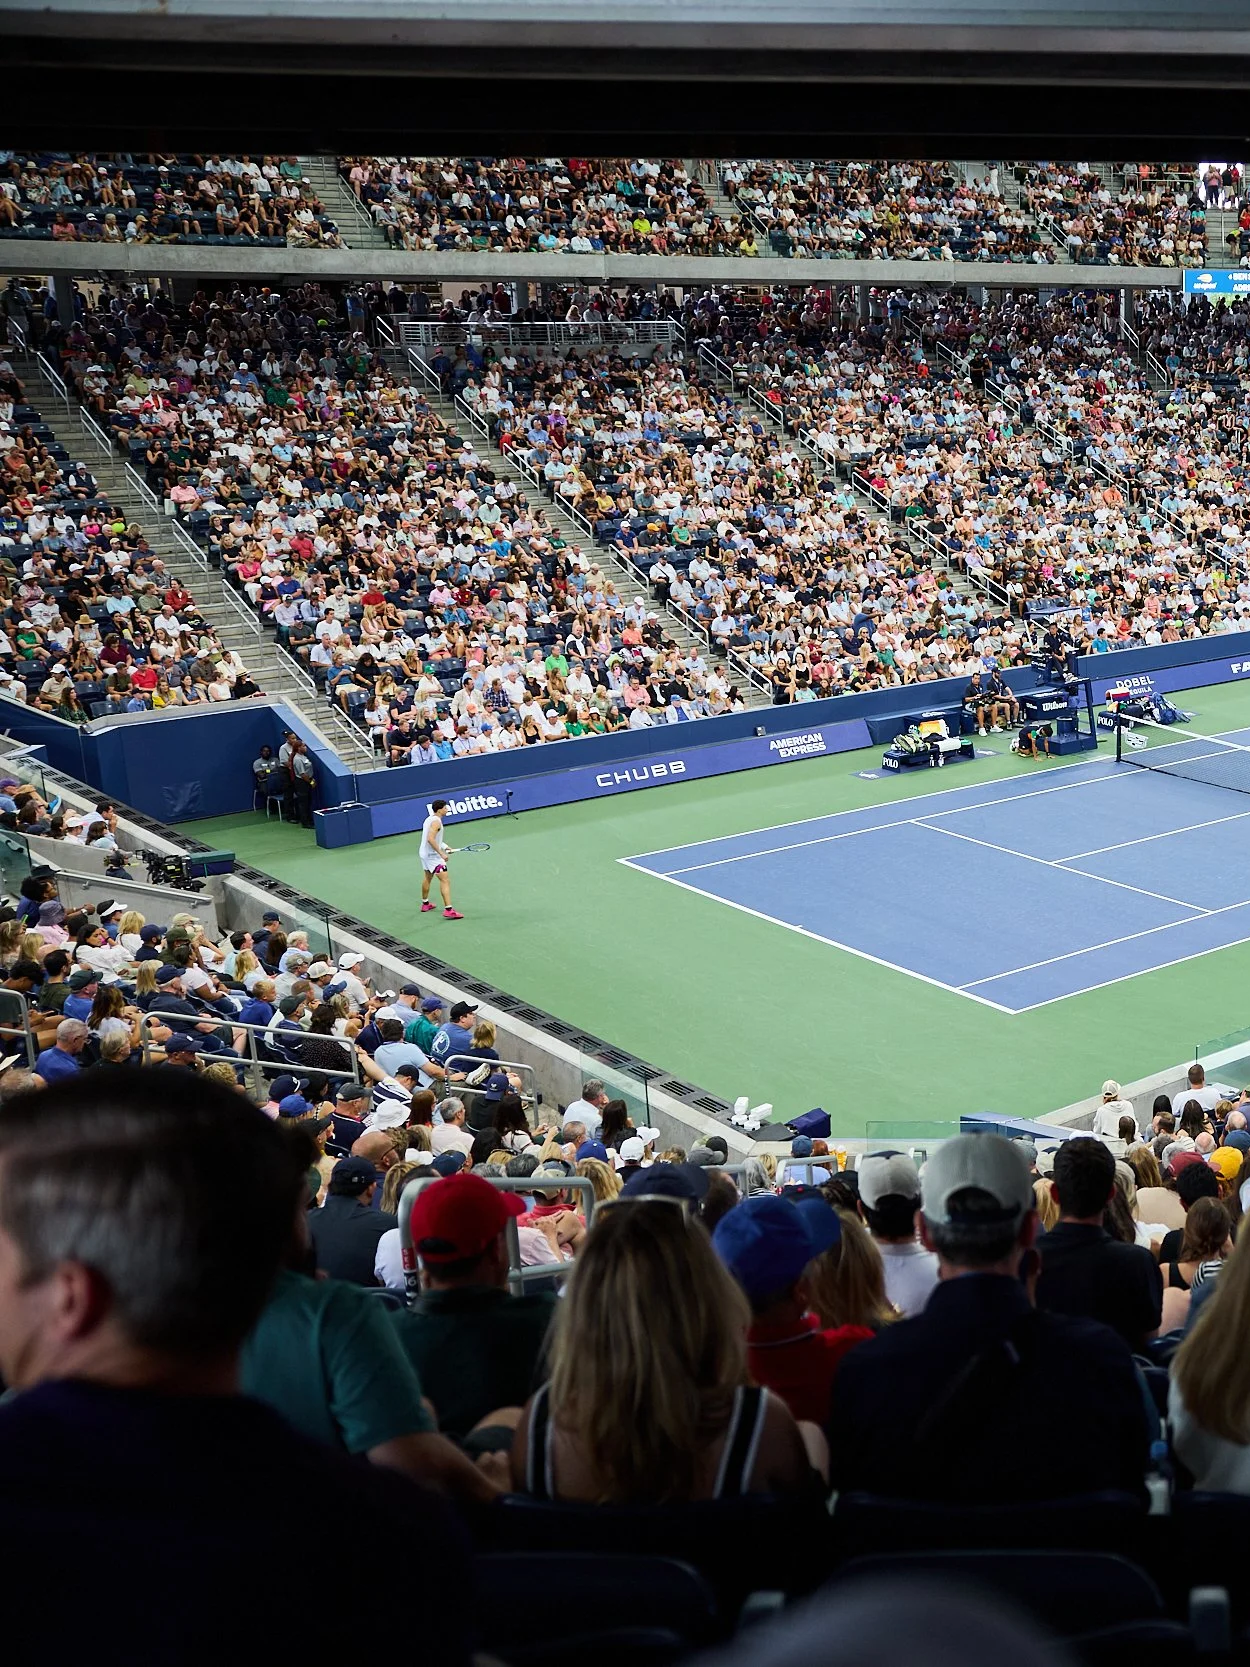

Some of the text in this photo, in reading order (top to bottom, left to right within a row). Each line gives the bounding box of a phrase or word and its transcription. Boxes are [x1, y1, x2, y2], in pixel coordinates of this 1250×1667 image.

[1115, 675, 1155, 689] DOBEL
[1129, 686, 1152, 696] EQUILA
[1041, 701, 1068, 712] Wilson
[1097, 716, 1114, 727] POLO
[769, 732, 823, 750] AMERICAN
[779, 741, 826, 758] EXPRESS
[882, 757, 899, 769] POLO
[595, 760, 686, 787] CHUBB
